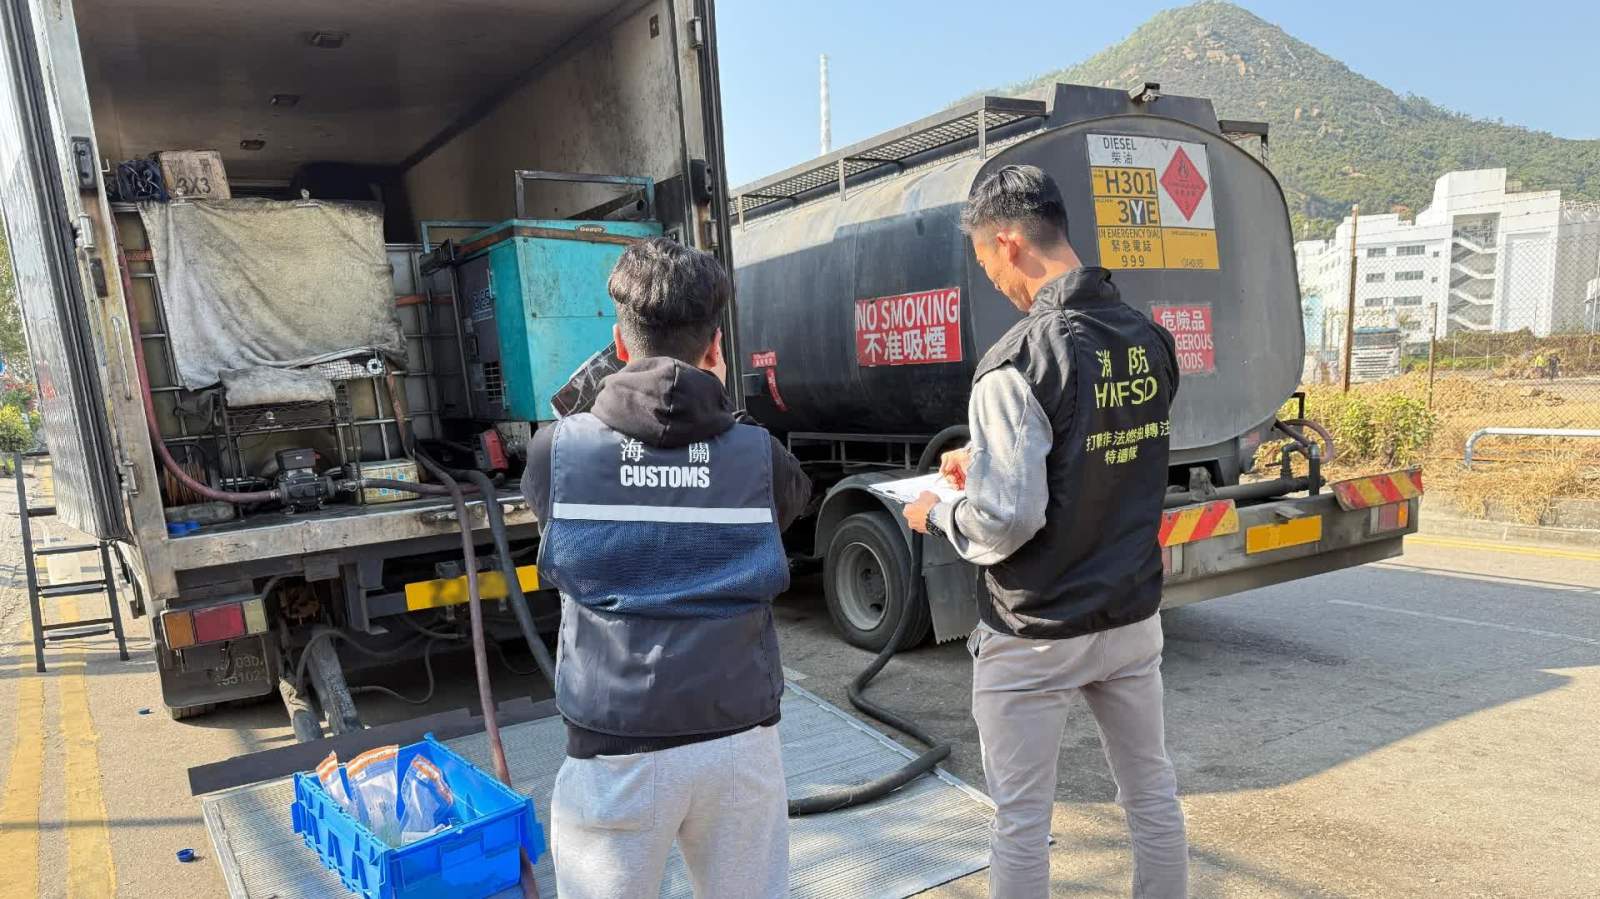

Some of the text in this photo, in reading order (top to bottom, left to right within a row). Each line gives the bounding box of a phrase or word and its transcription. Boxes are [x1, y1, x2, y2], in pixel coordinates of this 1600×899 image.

[1103, 137, 1137, 151] DIESEL
[1111, 151, 1133, 165] 柴油
[1104, 170, 1156, 195] H301
[1117, 199, 1158, 225] 3YE
[1107, 228, 1145, 240] EMERGENCY
[1121, 255, 1145, 268] 999
[856, 291, 959, 331] NO SMOKING
[1160, 310, 1205, 332] 危險品
[863, 326, 948, 363] 不准吸煙
[1175, 333, 1214, 351] GEROUS
[1176, 352, 1205, 369] OODS
[620, 438, 710, 464] 海關
[620, 464, 710, 488] CUSTOMS
